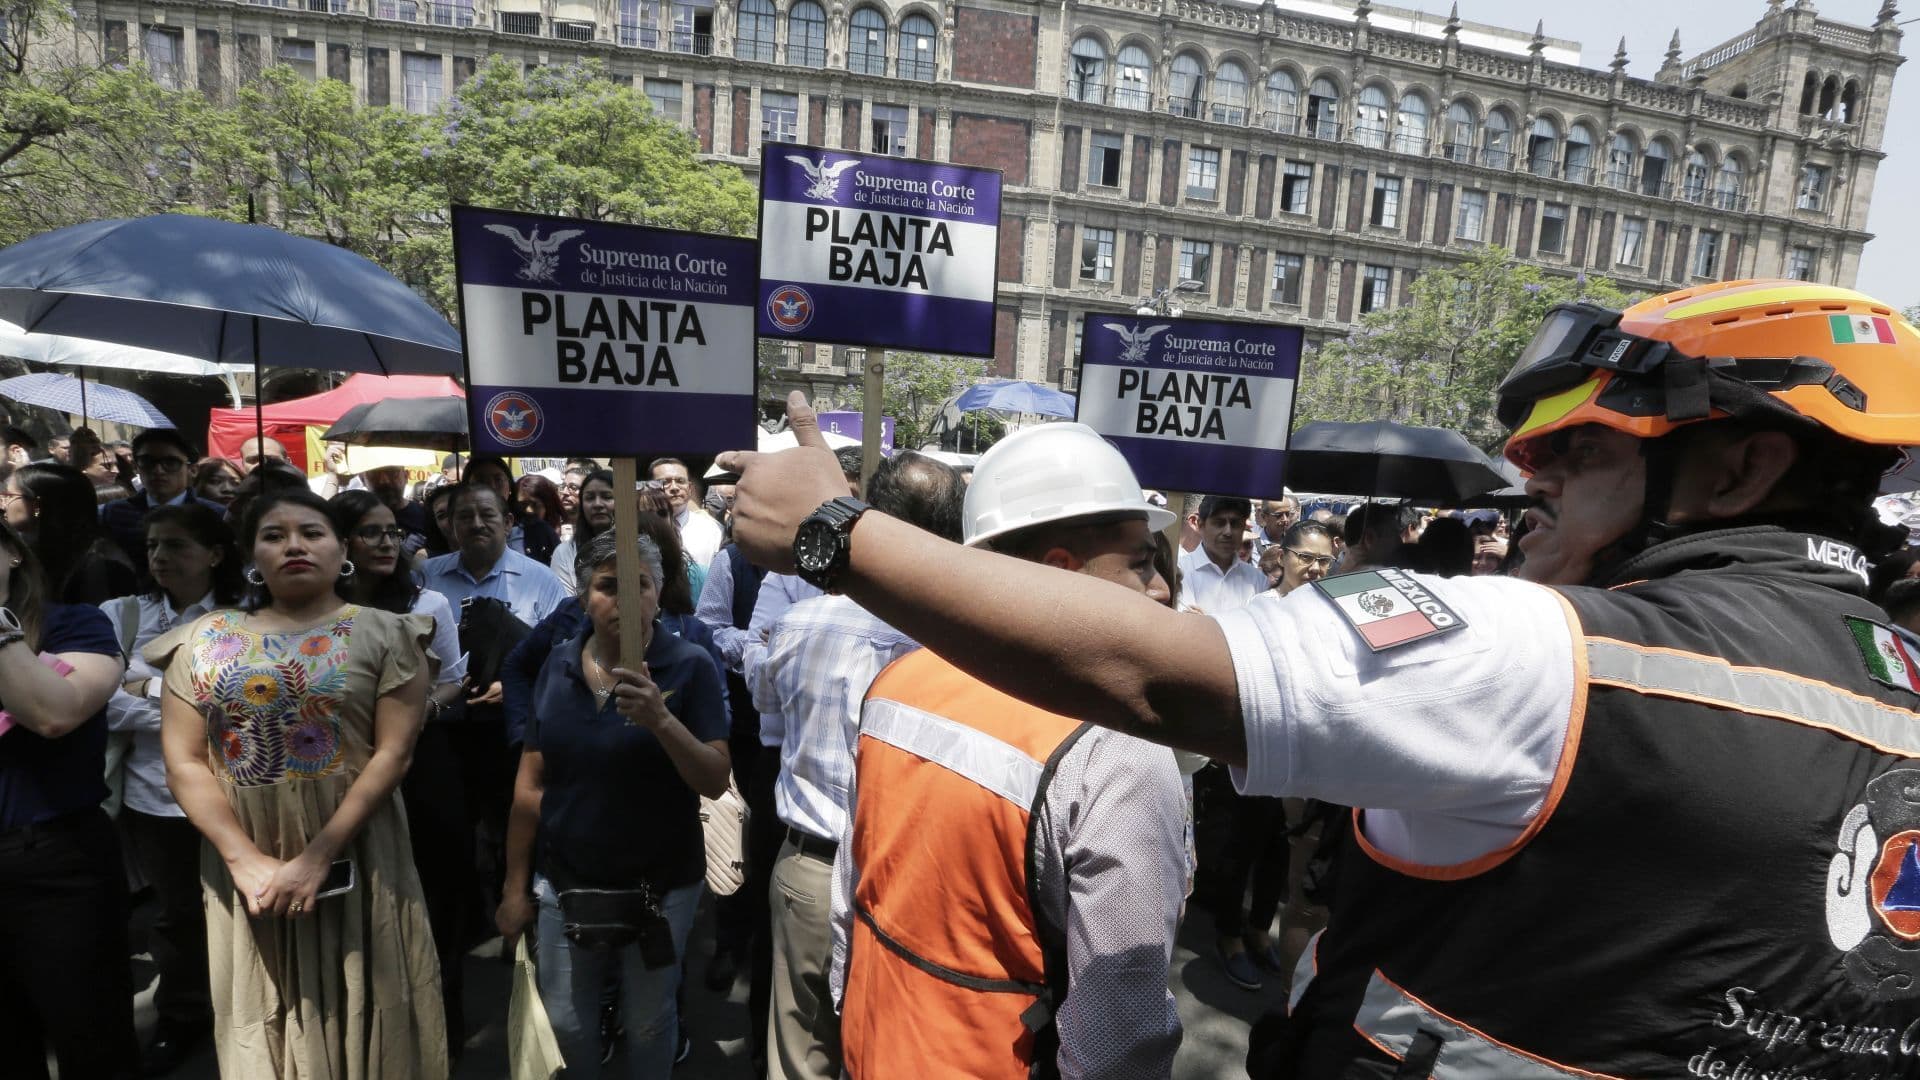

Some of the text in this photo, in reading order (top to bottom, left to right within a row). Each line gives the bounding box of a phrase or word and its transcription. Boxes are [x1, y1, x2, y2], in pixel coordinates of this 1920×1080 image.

[855, 170, 976, 201] Suprema Corte
[854, 190, 975, 216] de Justicia de la Nación
[805, 207, 954, 257] PLANTA
[579, 243, 728, 277] Suprema Corte
[828, 245, 929, 290] BAJA
[580, 269, 728, 295] de Justicia de la Nación
[521, 292, 707, 345] PLANTA
[1164, 333, 1276, 356] Suprema Corte
[1609, 340, 1630, 361] MSA
[557, 340, 680, 387] BAJA
[1162, 352, 1274, 371] de Justicia de la Nación
[1117, 368, 1252, 409] PLANTA
[831, 421, 841, 433] EL
[1135, 402, 1226, 441] BAJA
[1712, 986, 1896, 1056] Suprema
[1687, 1046, 1726, 1079] de
